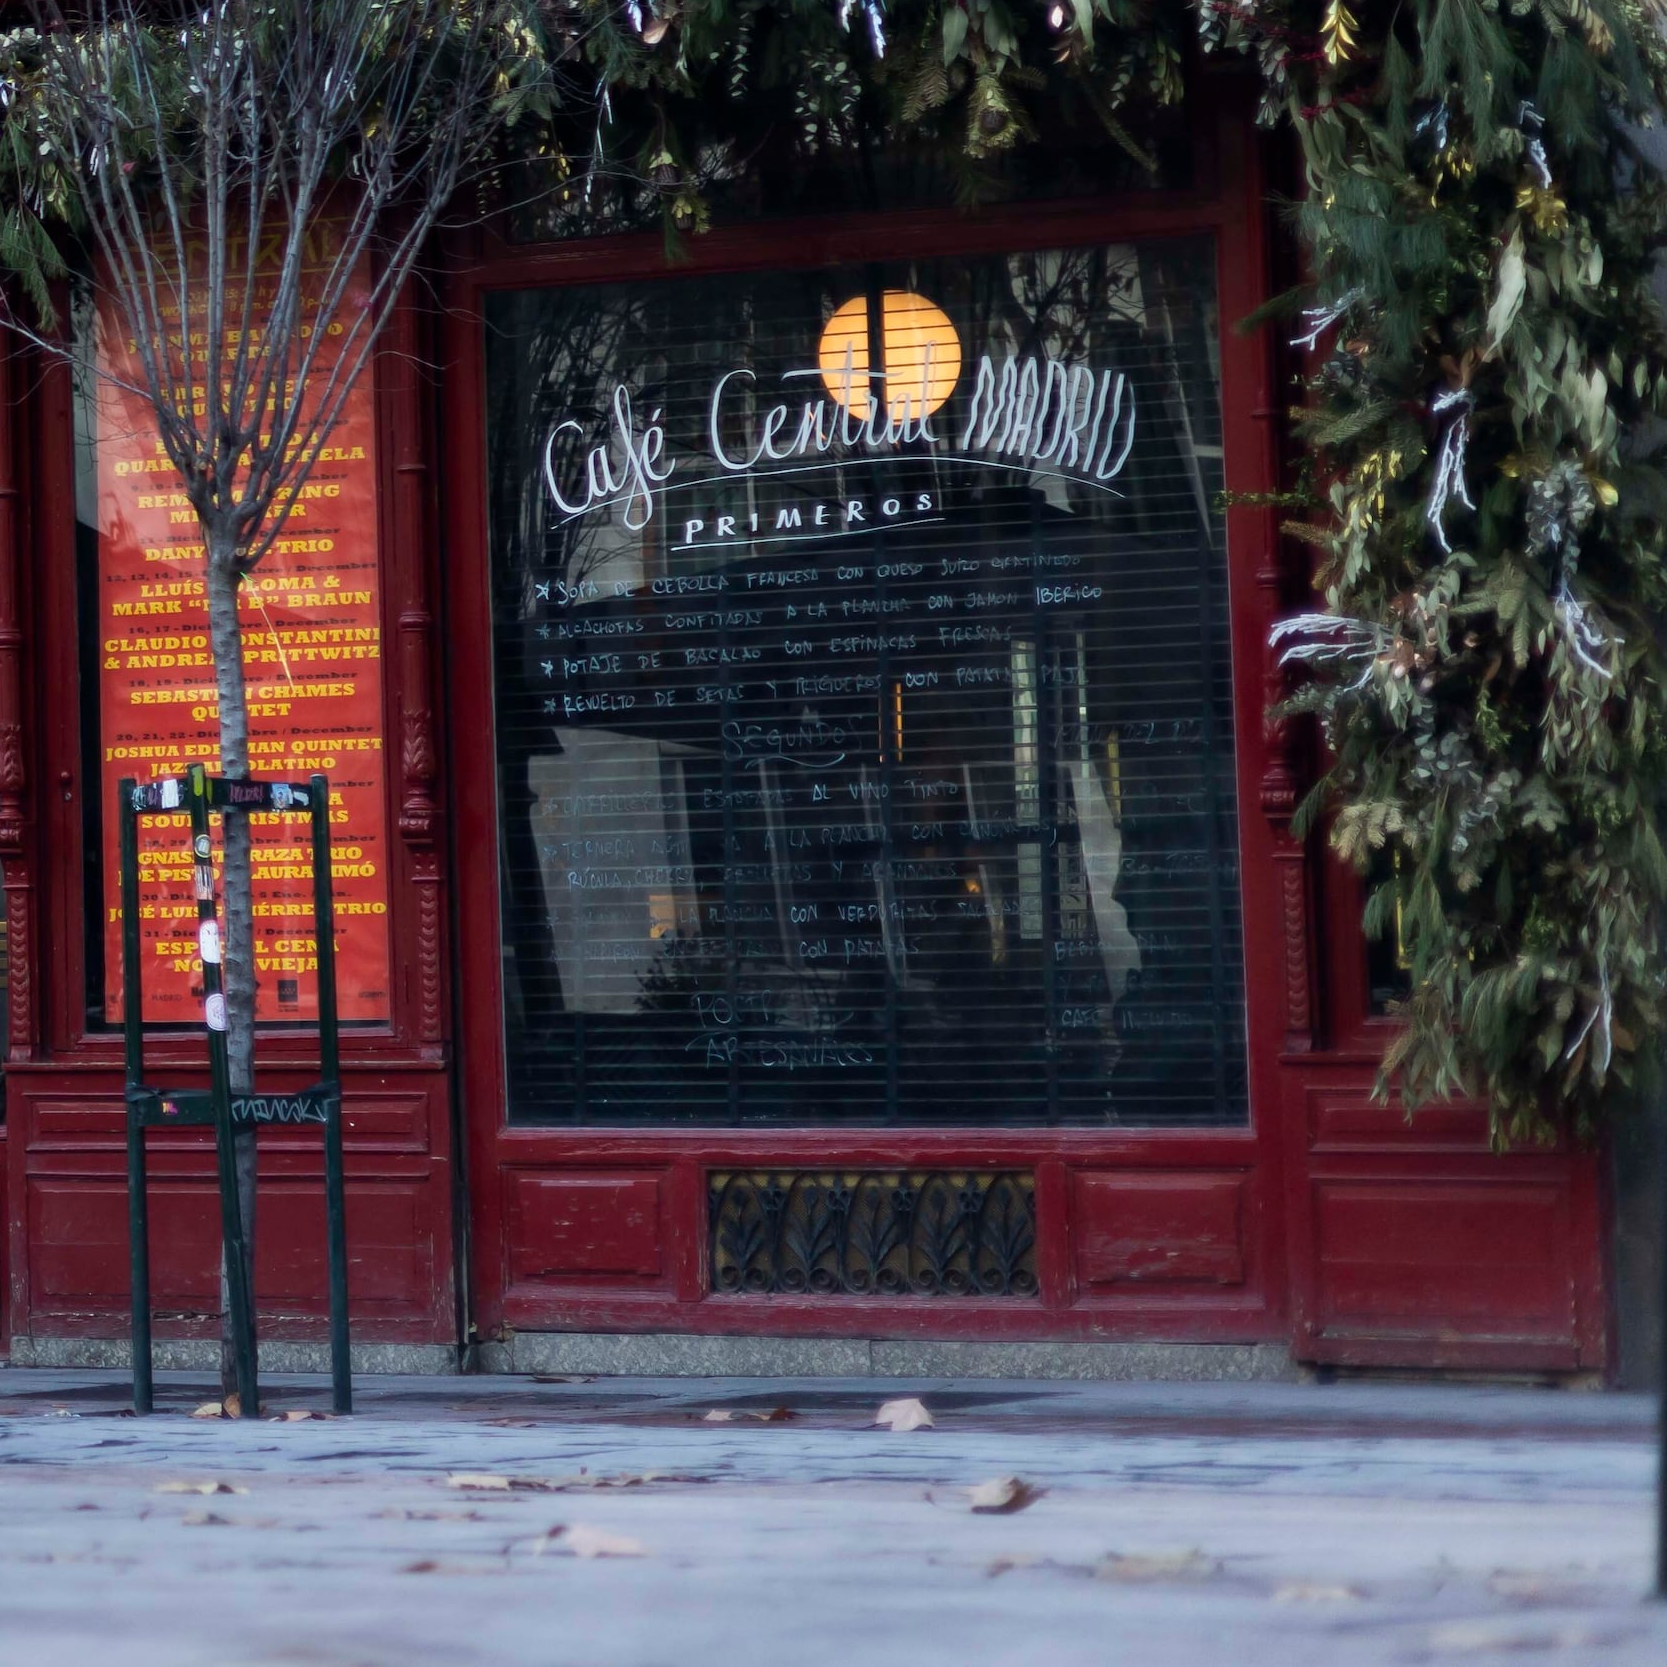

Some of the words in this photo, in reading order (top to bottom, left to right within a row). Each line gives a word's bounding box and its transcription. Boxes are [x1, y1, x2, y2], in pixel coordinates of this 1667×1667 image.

[544, 385, 676, 531] Café
[710, 339, 940, 471] Central
[685, 492, 935, 545] PRIMEROS
[276, 539, 334, 554] TRIO
[141, 581, 204, 598] LLUÍS
[323, 575, 340, 589] &
[557, 579, 599, 605] SOPA
[614, 579, 635, 598] DE
[651, 574, 730, 595] CEBOLLA
[836, 565, 865, 581] CON
[112, 600, 182, 616] MARK
[287, 591, 371, 607] BRAUN
[806, 601, 828, 618] LA
[927, 595, 955, 610] CON
[1035, 583, 1103, 605] IBERICO
[104, 635, 207, 652] CLAUDIO
[104, 656, 120, 670] &
[562, 653, 622, 680] POTAJE
[637, 651, 662, 669] DE
[783, 639, 814, 656] CON
[258, 683, 355, 700] CHAMES
[654, 690, 676, 708] DE
[905, 670, 940, 689] CON
[106, 744, 180, 761] JOSHUA
[291, 738, 383, 754] QUINTET
[849, 781, 890, 800] VINO
[789, 904, 819, 924] CON
[798, 939, 828, 959] CON
